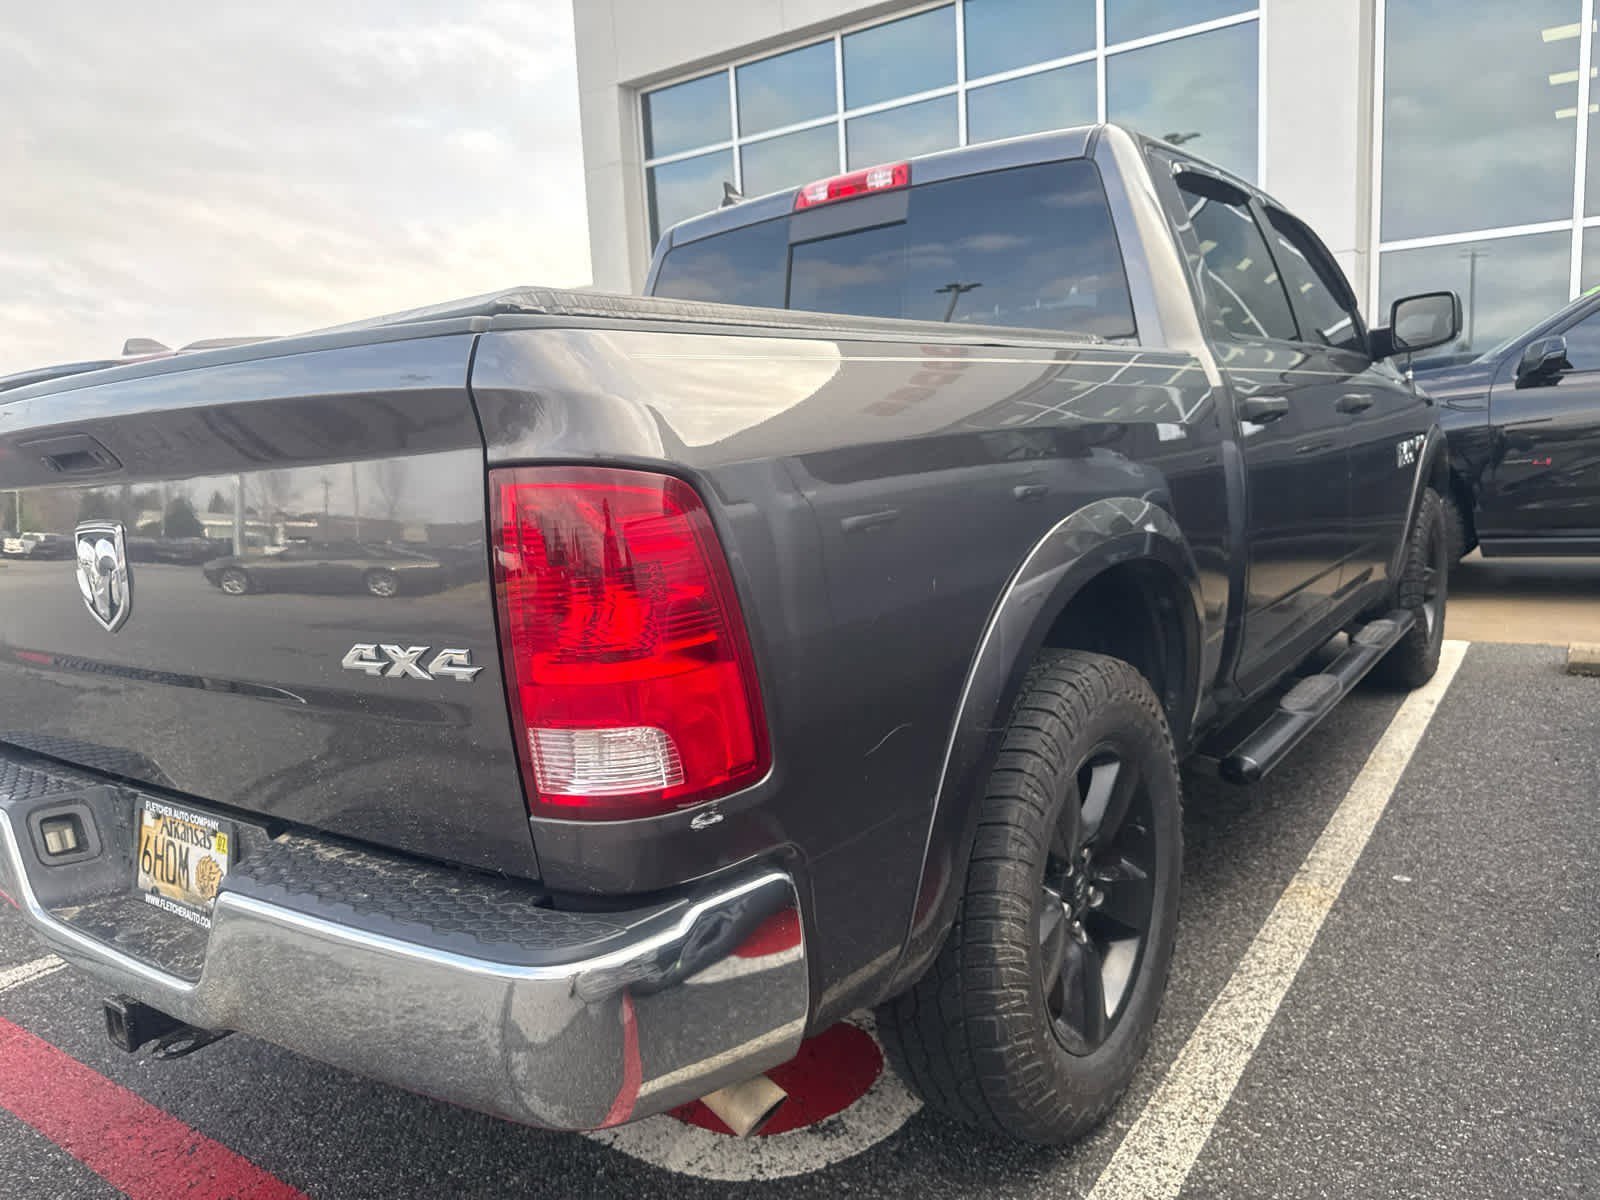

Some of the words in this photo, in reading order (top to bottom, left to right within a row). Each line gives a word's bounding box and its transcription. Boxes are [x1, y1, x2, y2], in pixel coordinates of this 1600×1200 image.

[145, 800, 173, 816] FLETCHER
[173, 810, 189, 822] AUTO
[189, 813, 219, 831] COMPANY
[160, 815, 212, 850] Arkansas
